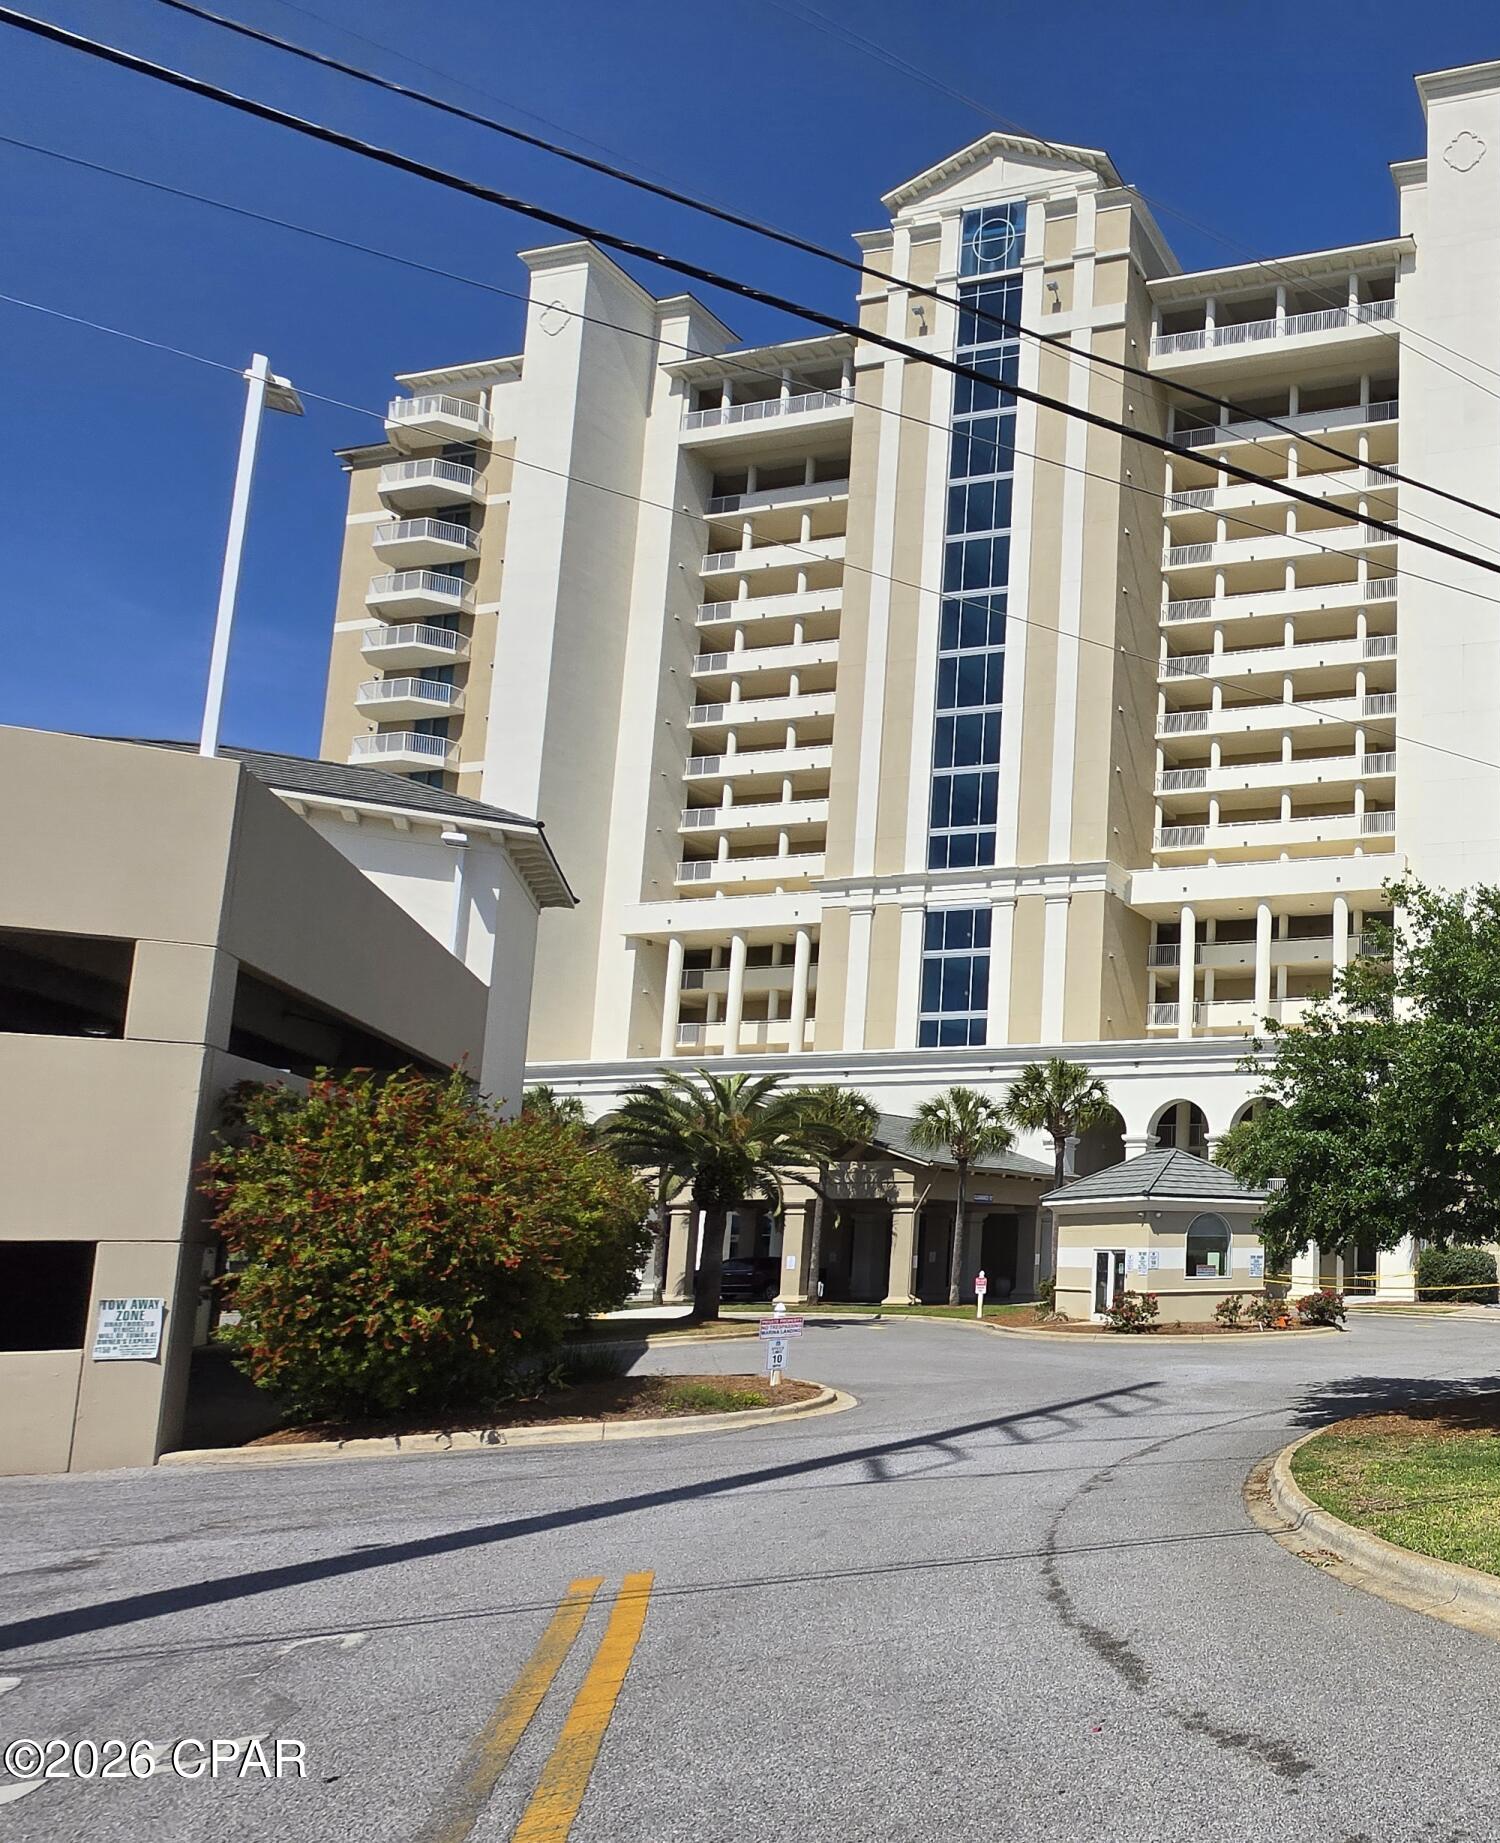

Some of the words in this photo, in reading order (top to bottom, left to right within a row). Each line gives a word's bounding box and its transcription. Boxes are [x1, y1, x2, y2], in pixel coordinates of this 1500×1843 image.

[101, 1299, 128, 1310] TOW
[130, 1299, 160, 1309] AWAY
[116, 1310, 145, 1321] ZONE
[772, 1354, 783, 1363] 10
